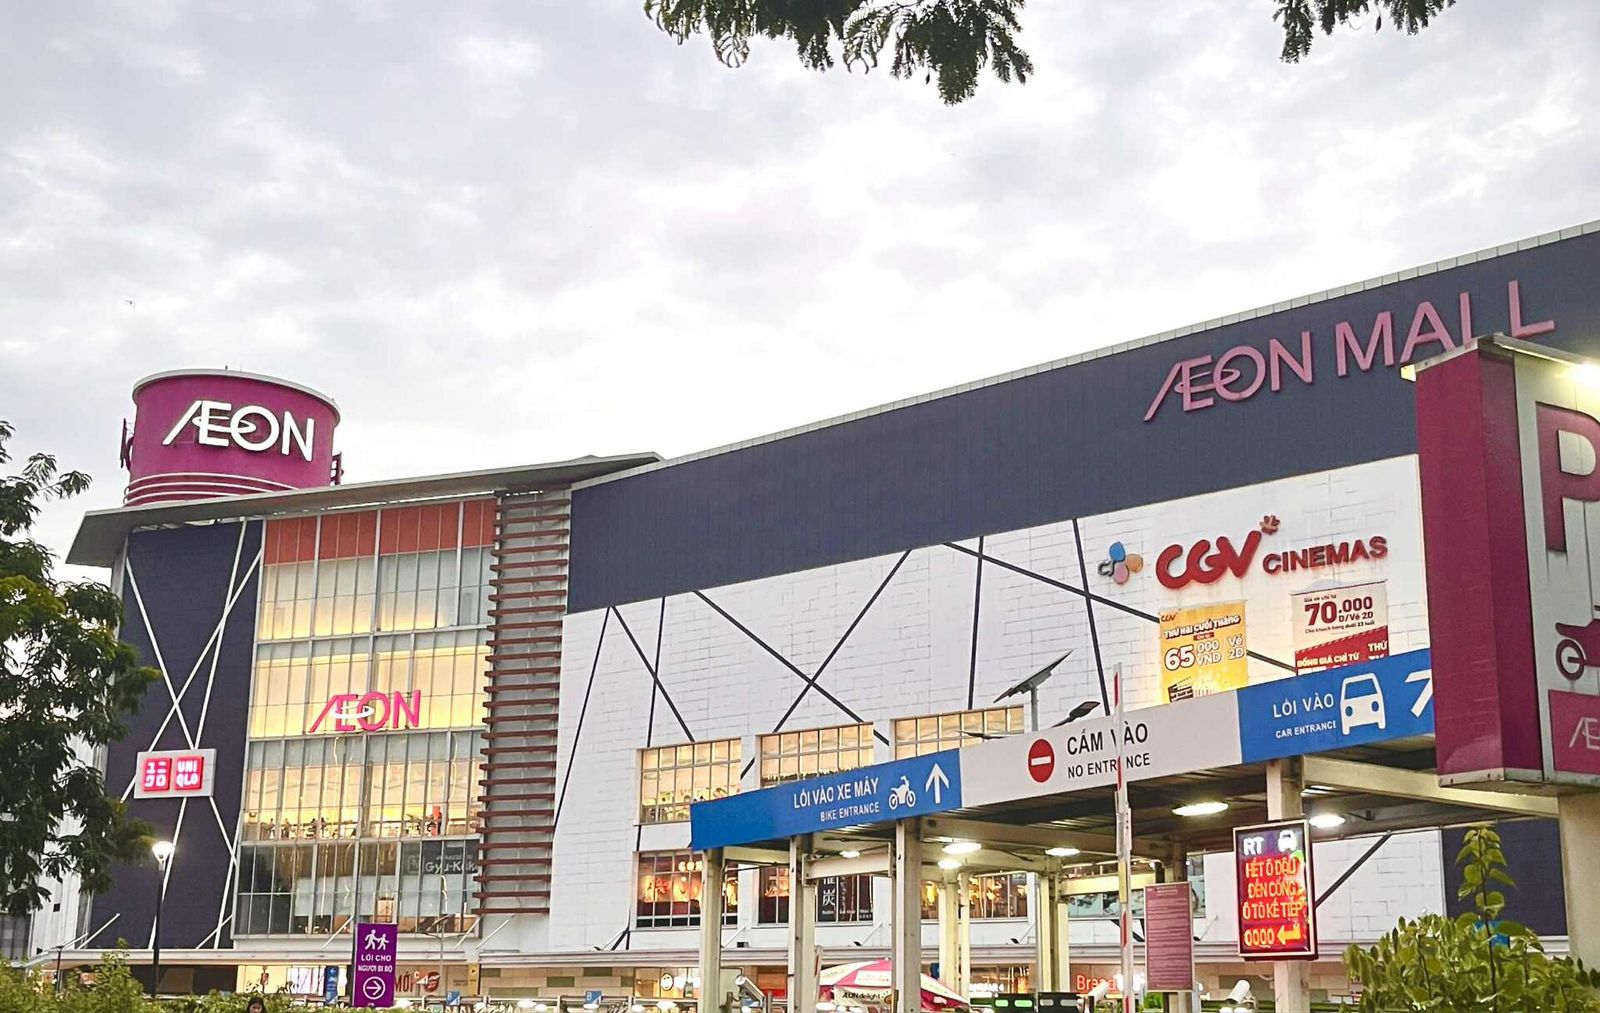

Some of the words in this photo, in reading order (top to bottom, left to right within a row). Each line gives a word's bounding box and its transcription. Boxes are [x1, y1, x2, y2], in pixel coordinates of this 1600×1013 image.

[1535, 401, 1600, 554] P
[1156, 530, 1262, 589] CGV
[1262, 536, 1388, 575] CINEMAS
[1195, 652, 1221, 666] VND
[1228, 647, 1244, 660] 2D
[1302, 692, 1335, 712] VÀO
[1275, 727, 1293, 739] CAR
[1294, 719, 1337, 736] ENTRANCE
[1068, 764, 1083, 779] NO
[1087, 753, 1151, 775] ENTRNCE
[812, 785, 834, 805] VÀO
[837, 783, 851, 801] XE
[820, 809, 837, 822] BIKE
[839, 802, 879, 819] ENTRANCE
[1244, 928, 1275, 946] 0000
